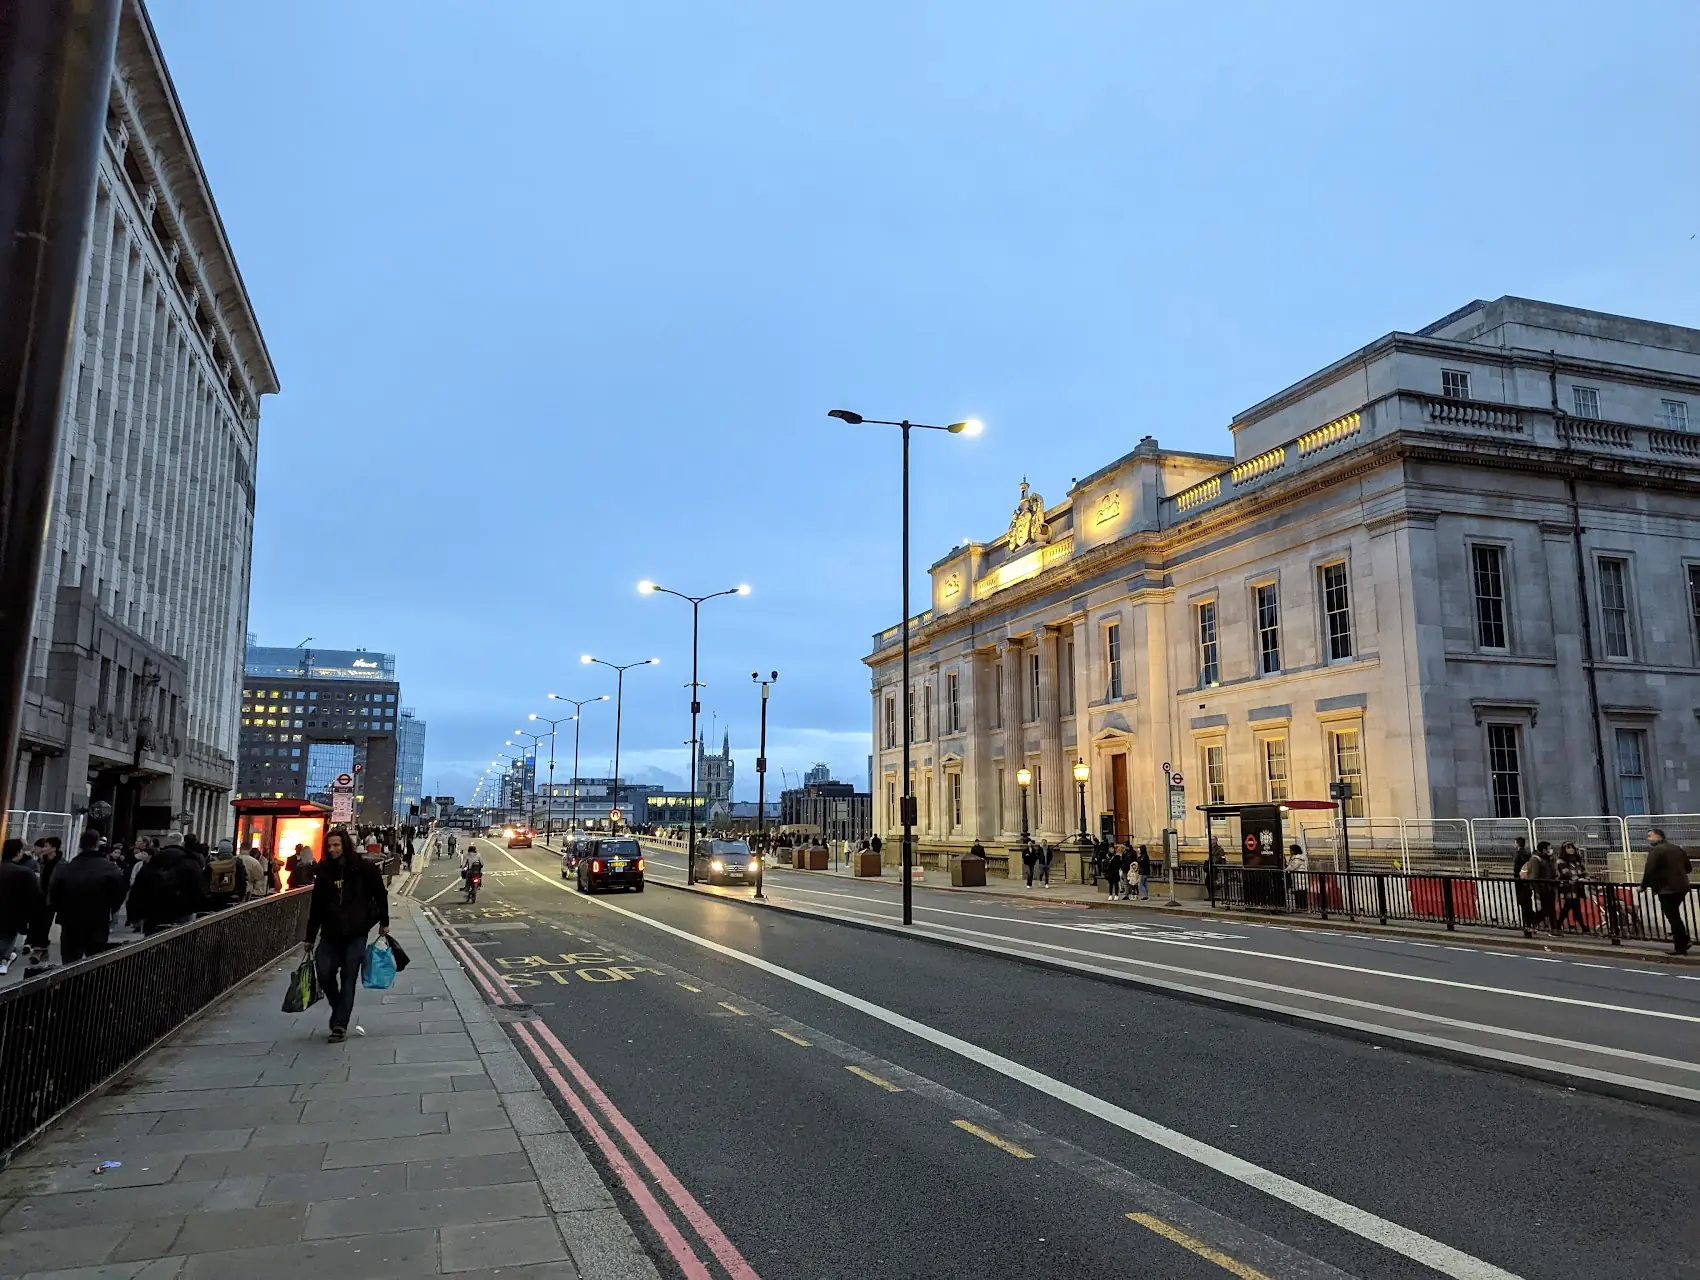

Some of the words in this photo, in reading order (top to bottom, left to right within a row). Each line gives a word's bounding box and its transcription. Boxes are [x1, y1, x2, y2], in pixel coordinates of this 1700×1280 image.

[355, 764, 361, 772] P
[495, 952, 615, 969] BUS
[501, 966, 666, 988] STOP
